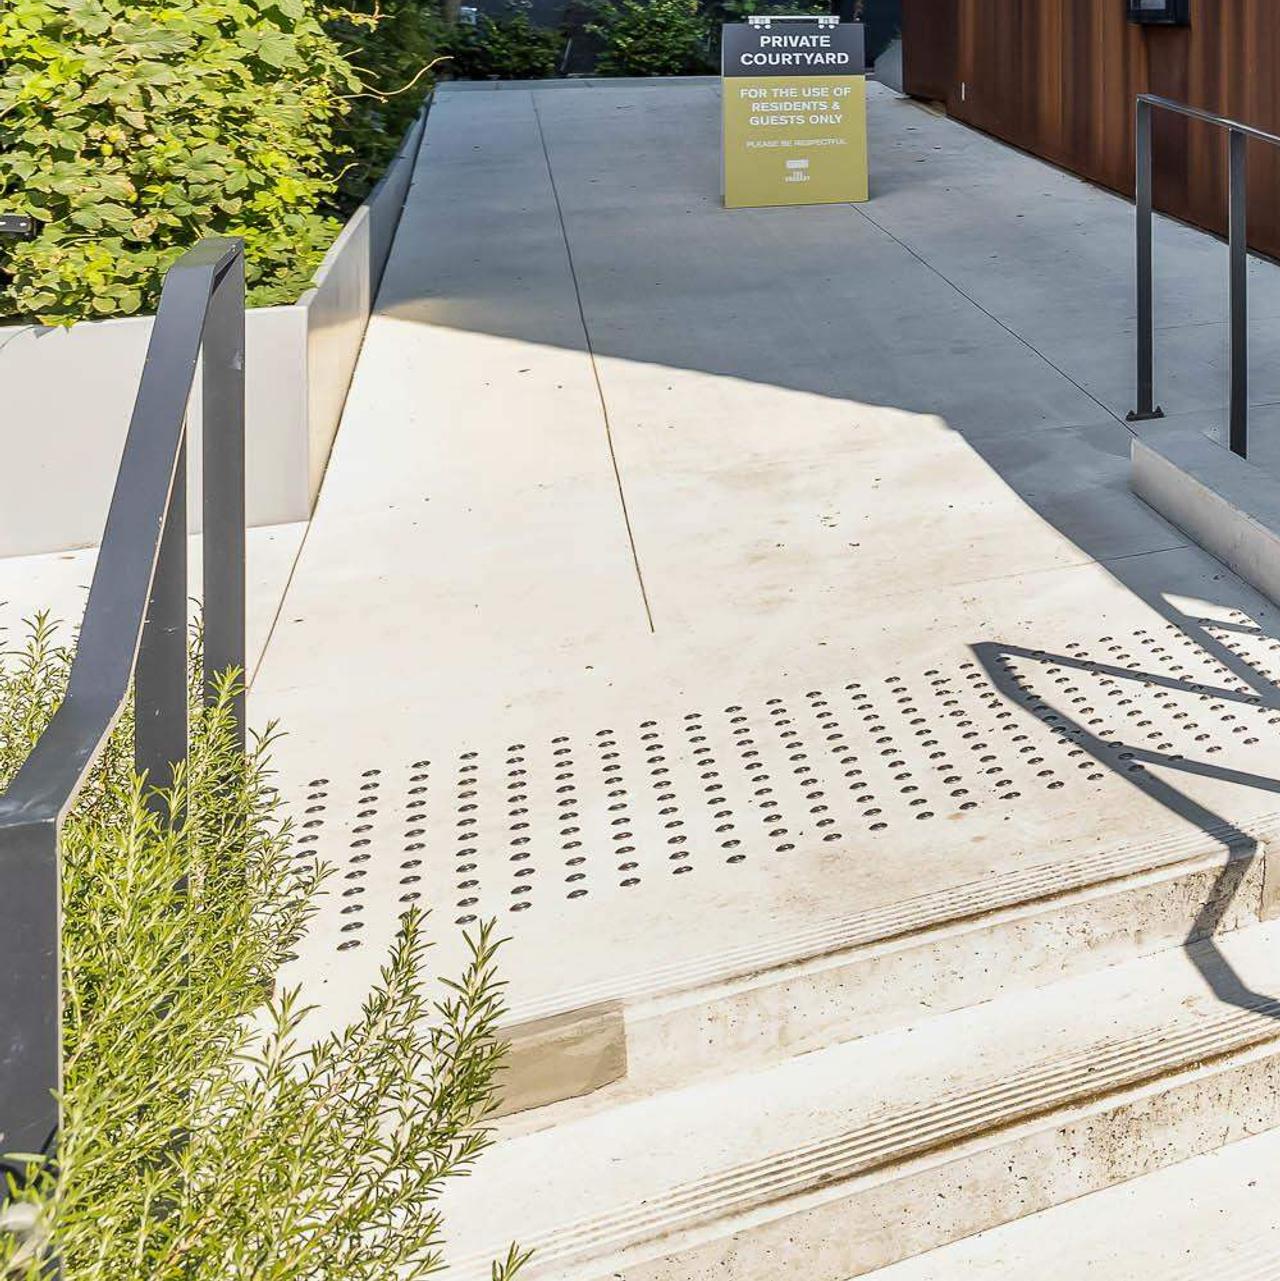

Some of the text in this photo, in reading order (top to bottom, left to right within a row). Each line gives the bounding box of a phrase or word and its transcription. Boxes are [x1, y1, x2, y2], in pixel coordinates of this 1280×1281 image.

[760, 34, 831, 48] PRIVATE
[740, 52, 849, 66] COURTYARD
[740, 86, 851, 99] FOR THE USE OF
[751, 100, 841, 112] RESIDENTS &
[750, 114, 843, 126] GUESTS ONLY
